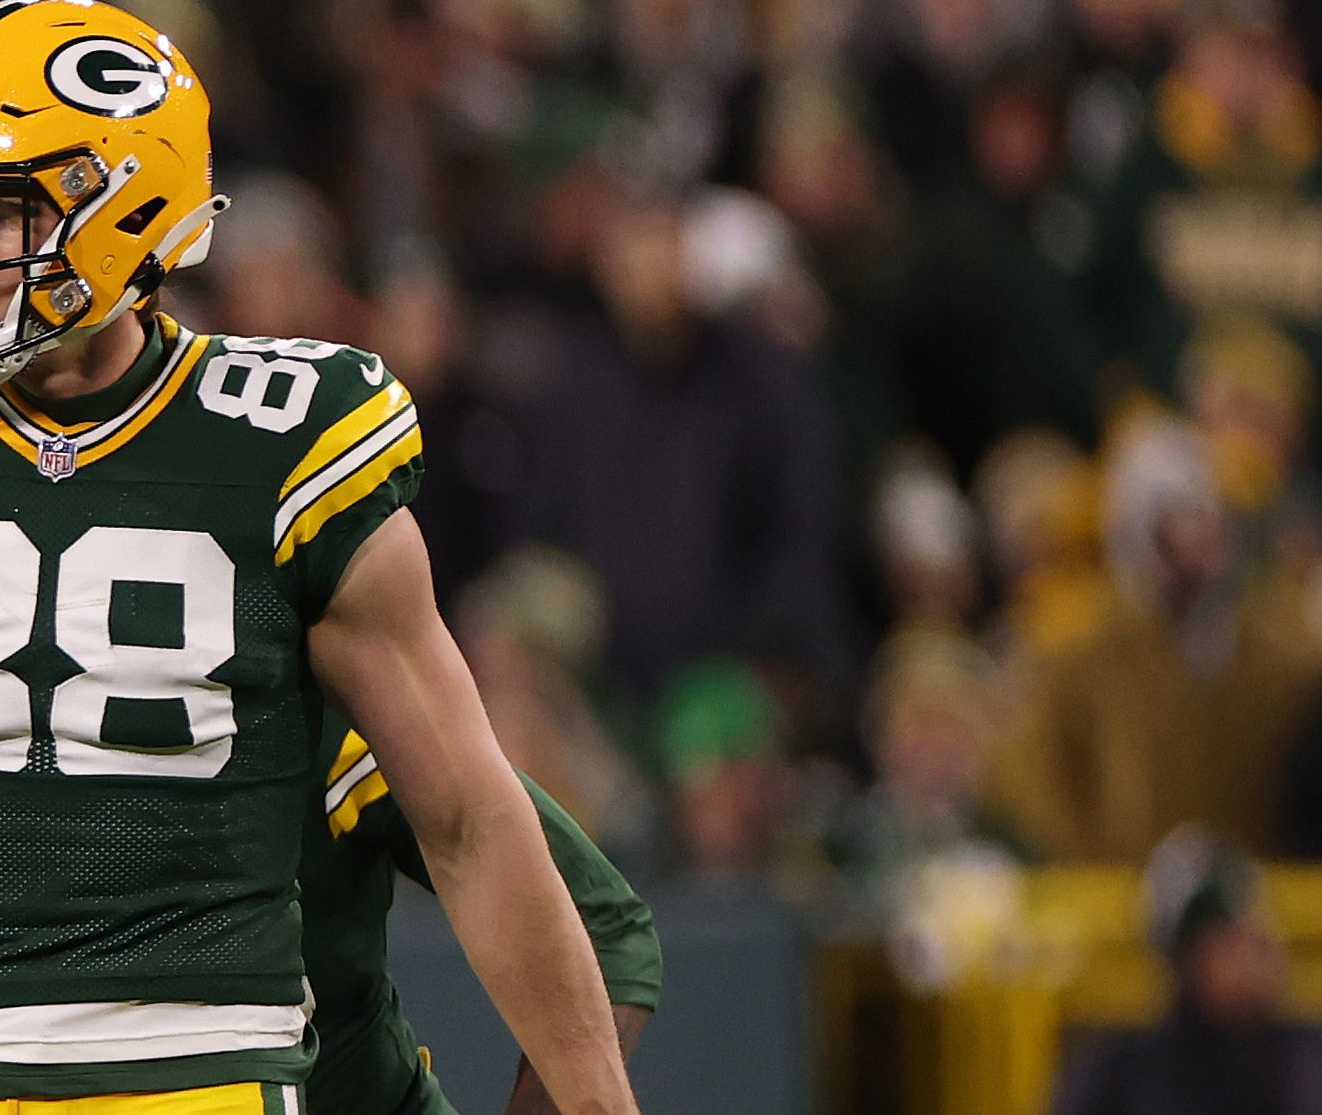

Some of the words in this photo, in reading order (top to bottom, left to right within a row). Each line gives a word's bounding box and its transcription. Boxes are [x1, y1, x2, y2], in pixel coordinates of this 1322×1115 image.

[45, 36, 167, 117] G
[197, 336, 343, 434] 88
[44, 453, 70, 473] NFL
